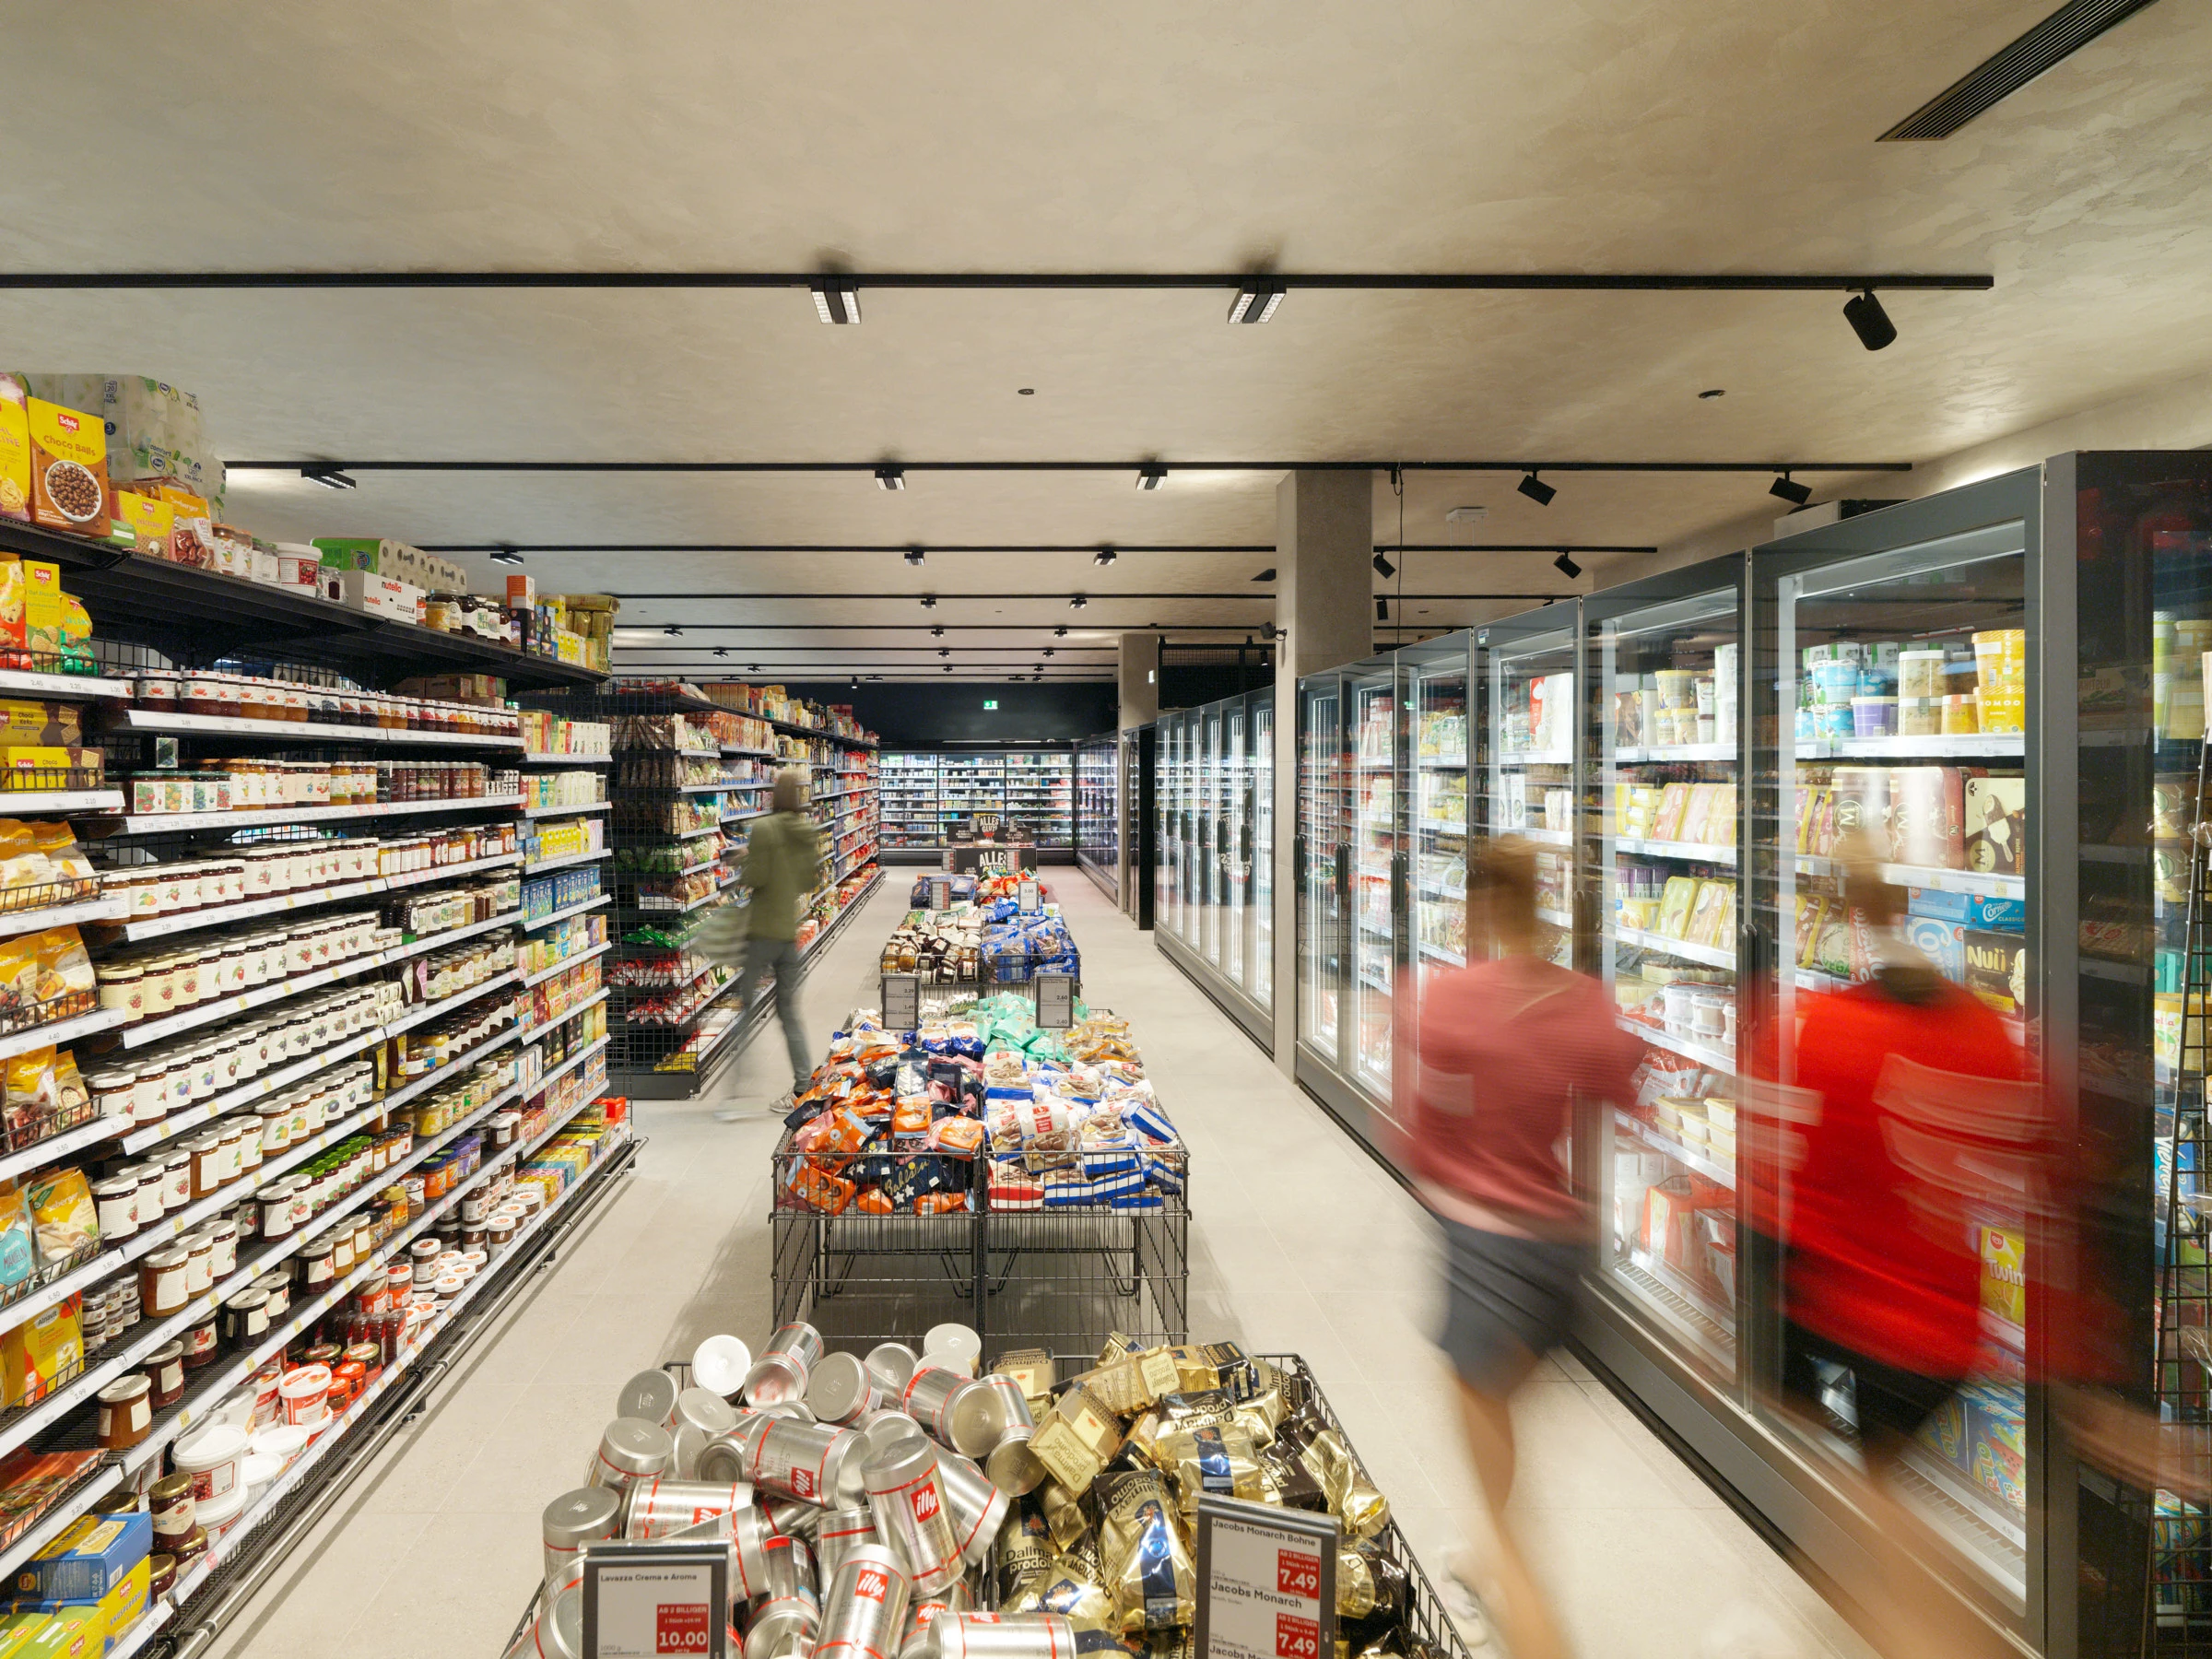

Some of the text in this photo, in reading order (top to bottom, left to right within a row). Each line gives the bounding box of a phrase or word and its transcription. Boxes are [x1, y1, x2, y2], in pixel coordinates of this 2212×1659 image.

[43, 434, 96, 456] Choco Balls
[149, 444, 171, 457] comfort
[381, 581, 402, 594] nutella
[364, 596, 381, 606] nutella
[980, 816, 999, 827] ALLES
[1839, 805, 1857, 826] M
[1967, 945, 2006, 973] Nuii
[884, 1159, 930, 1196] Bahlsen
[1985, 1257, 2026, 1287] Twin
[47, 1290, 61, 1301] 5.50
[38, 1311, 58, 1326] Alnavit
[74, 1389, 87, 1400] 2.99
[1047, 1443, 1082, 1484] Dallmayr
[1054, 1437, 1088, 1473] prodomo
[792, 1469, 813, 1497] illy
[70, 1503, 84, 1515] 3.20
[915, 1485, 939, 1519] illy
[1213, 1520, 1316, 1547] Jacobs Monarch Bohne
[1292, 1552, 1319, 1563] BILLIGER
[857, 1572, 886, 1598] illy
[1279, 1568, 1318, 1591] 7.49
[1211, 1581, 1302, 1609] Jacobs Monarch
[146, 1618, 159, 1631] 1.80
[1291, 1617, 1318, 1628] BILLIGER
[659, 1631, 707, 1647] 10.00
[1278, 1632, 1316, 1655] 7.49
[1209, 1645, 1245, 1659] Jacobs
